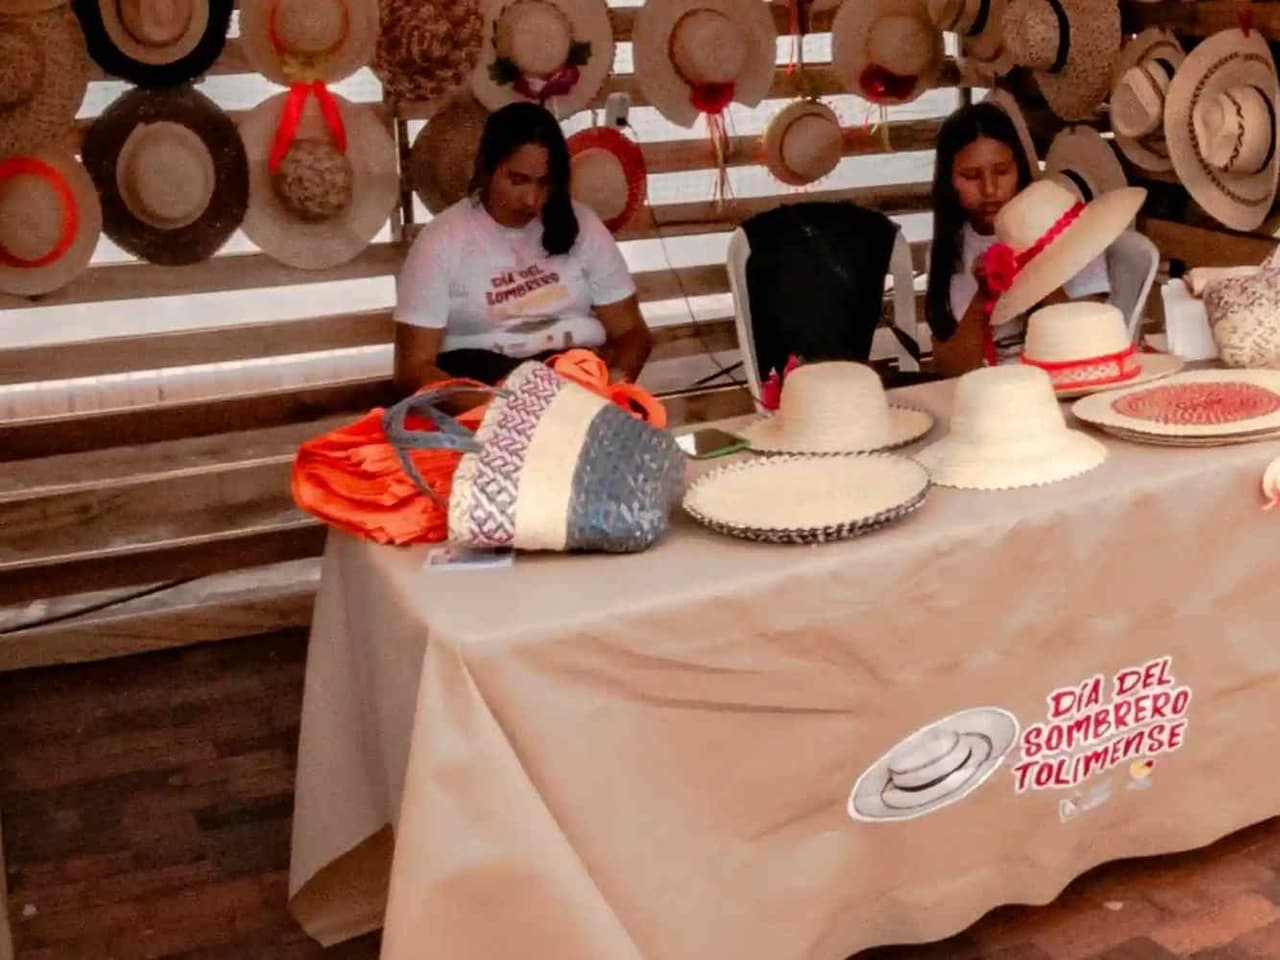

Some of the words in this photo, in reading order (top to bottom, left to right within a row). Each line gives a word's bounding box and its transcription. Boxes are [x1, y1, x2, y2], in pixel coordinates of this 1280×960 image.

[1050, 675, 1102, 718] DÍA
[1116, 658, 1172, 696] DEL
[1015, 722, 1186, 790] TOLIMENSE
[1023, 690, 1190, 757] SOMBRERO
